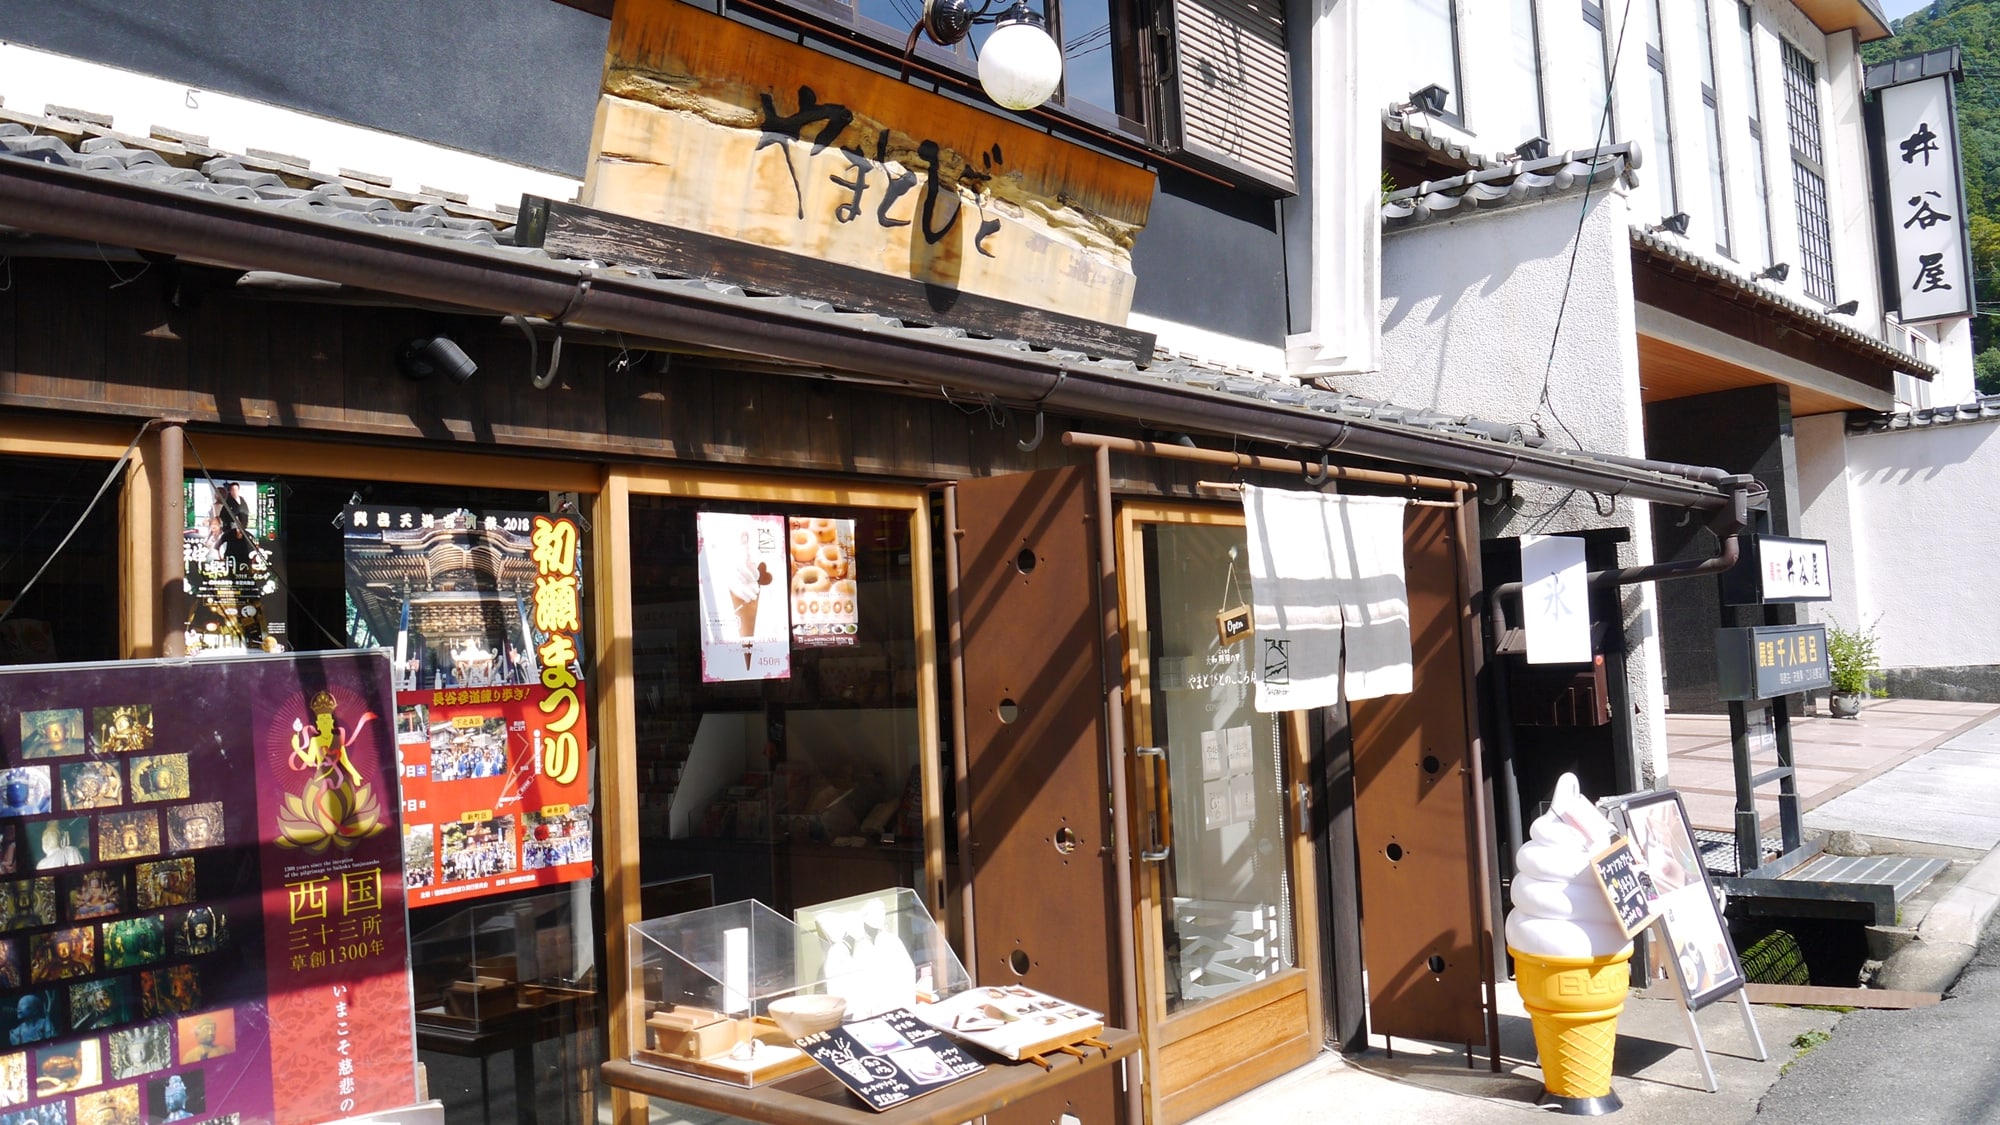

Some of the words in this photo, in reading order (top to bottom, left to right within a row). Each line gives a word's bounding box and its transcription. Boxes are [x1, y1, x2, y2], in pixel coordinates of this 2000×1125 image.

[756, 86, 1004, 258] やまとびと
[1900, 123, 1952, 293] 井谷屋
[503, 517, 530, 532] 2018
[1543, 571, 1574, 622] 氷
[1227, 620, 1244, 635] Open
[533, 518, 579, 784] 初瀬まつり
[1758, 635, 1818, 668] 展望千人風呂
[284, 867, 382, 925] 西国
[288, 914, 383, 951] 三十三所
[289, 939, 385, 972] 草創1300年
[332, 985, 356, 1118] いまこそ慈悲の
[795, 1030, 832, 1048] CAFE
